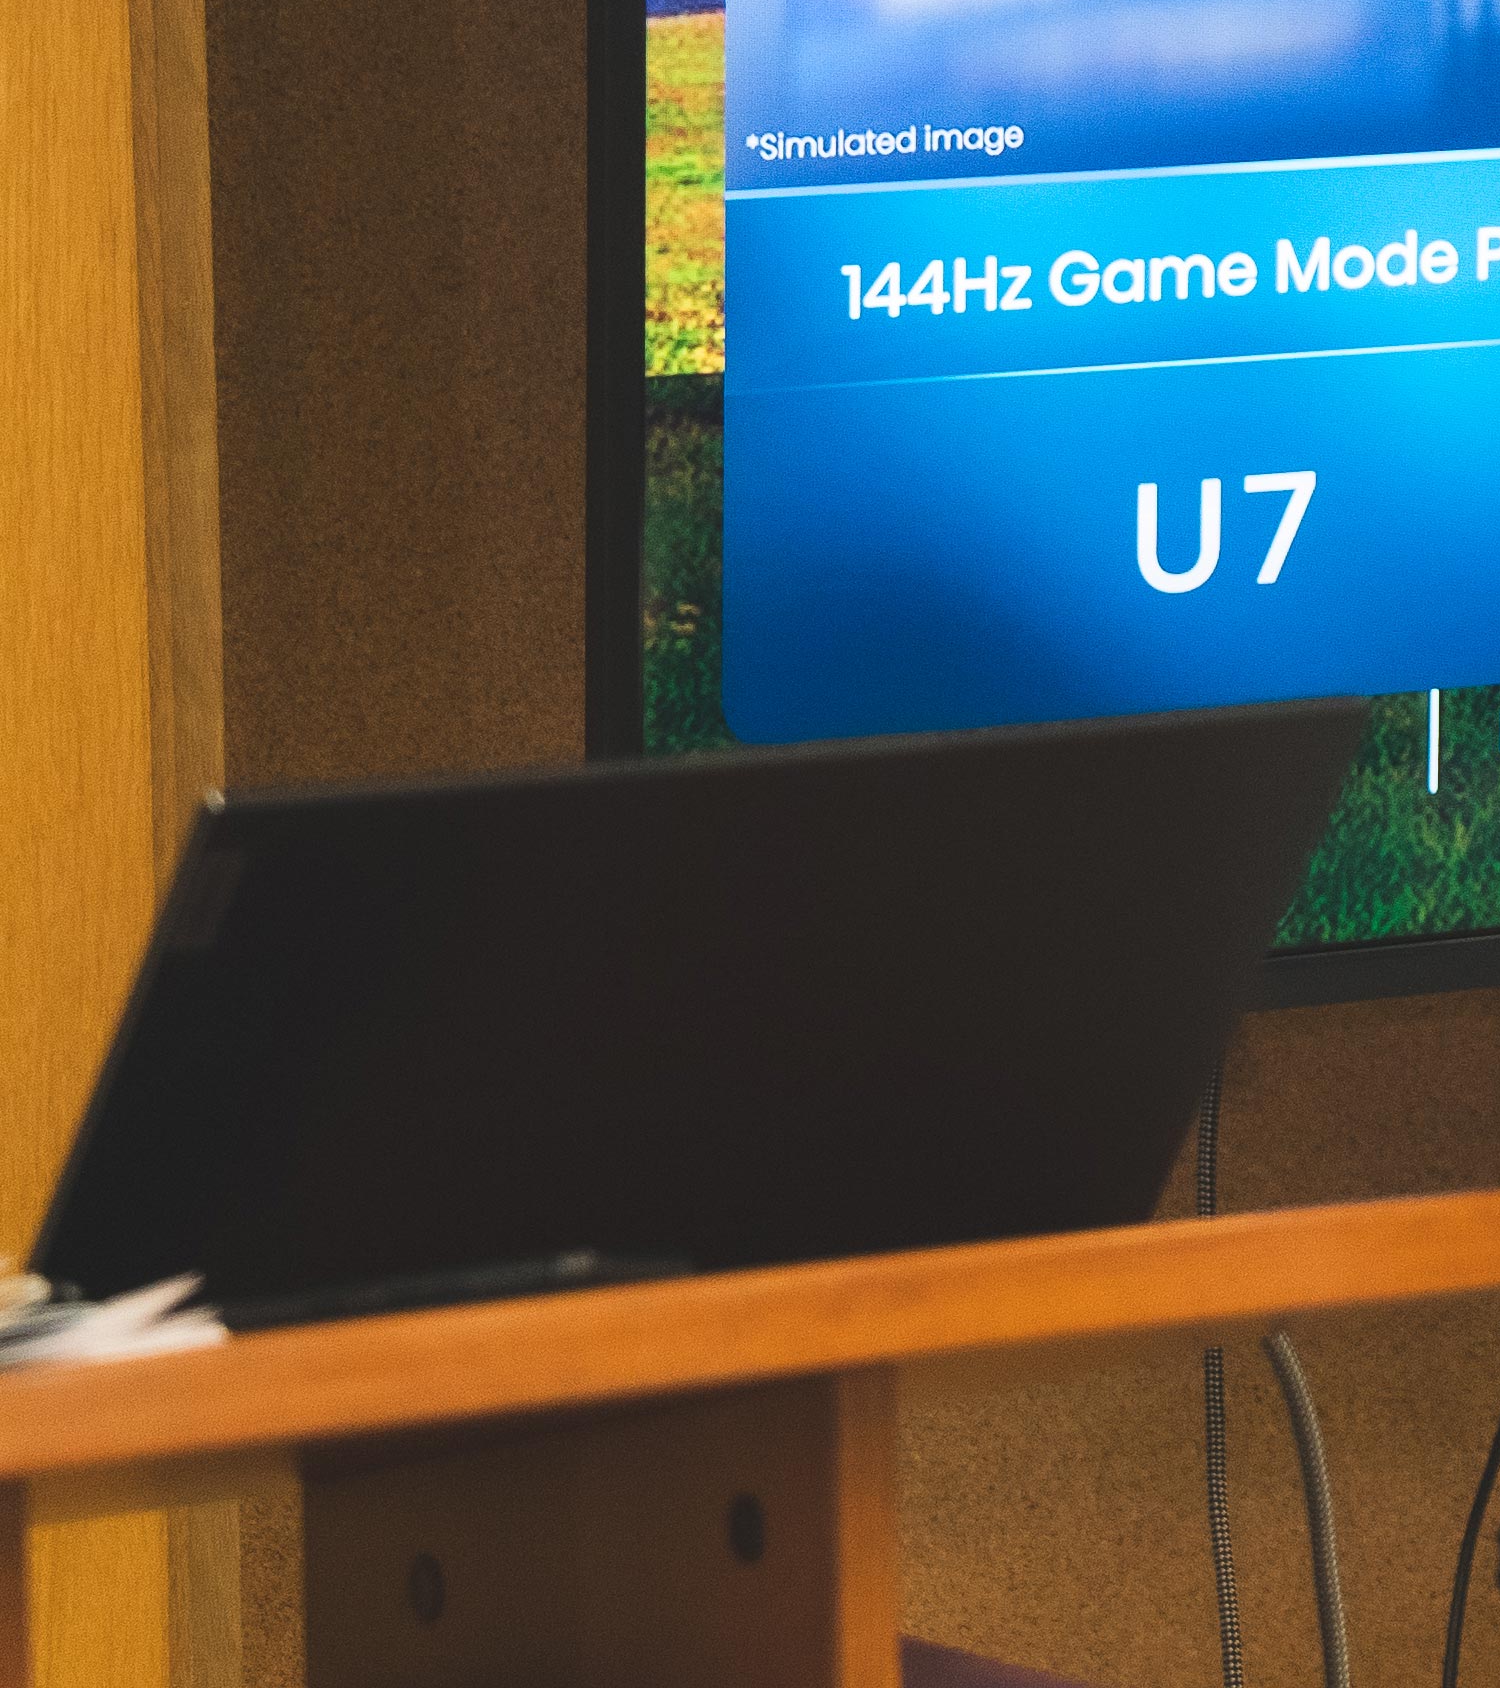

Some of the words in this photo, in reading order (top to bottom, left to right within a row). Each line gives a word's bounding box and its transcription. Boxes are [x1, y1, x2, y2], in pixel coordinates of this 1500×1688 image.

[923, 123, 1025, 157] image
[839, 254, 1034, 321] 144Hz
[1047, 248, 1259, 308] Game
[1274, 227, 1460, 295] Mode
[1135, 469, 1318, 595] U7
